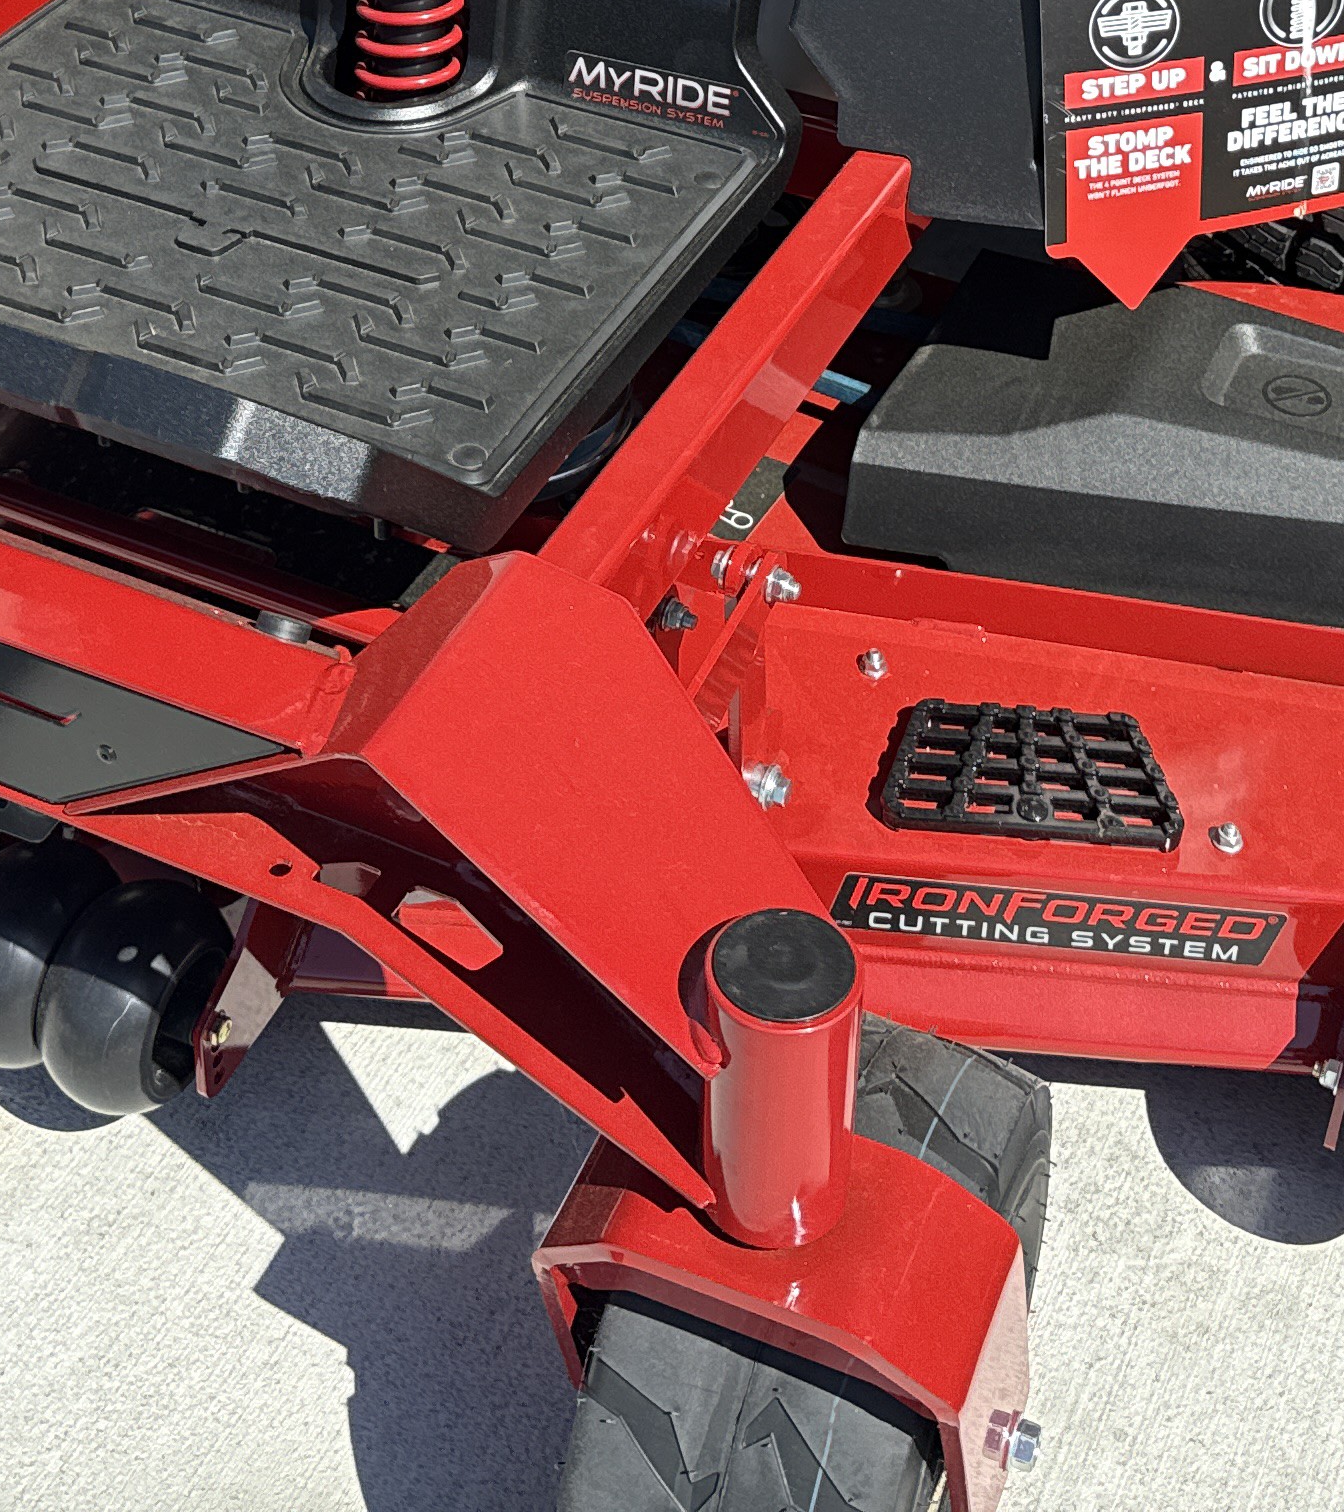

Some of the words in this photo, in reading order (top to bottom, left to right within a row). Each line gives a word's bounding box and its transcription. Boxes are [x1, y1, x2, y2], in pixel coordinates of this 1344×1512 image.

[1208, 60, 1227, 82] &
[1242, 53, 1282, 78] SIT
[1081, 72, 1146, 101] STEP
[1151, 67, 1187, 91] UP
[1231, 87, 1274, 100] PATENTED
[572, 87, 662, 116] SUSPENSION
[666, 107, 725, 129] SYSTEM
[1064, 112, 1092, 124] HEAVY
[1095, 110, 1118, 120] DUTY
[1182, 98, 1205, 109] DECK
[1240, 101, 1298, 129] FEEL
[1087, 125, 1174, 157] STOMP
[1073, 154, 1123, 180] THE
[1128, 143, 1193, 173] DECK
[867, 911, 1050, 945] CUTTING
[1069, 930, 1240, 962] SYSTEM
